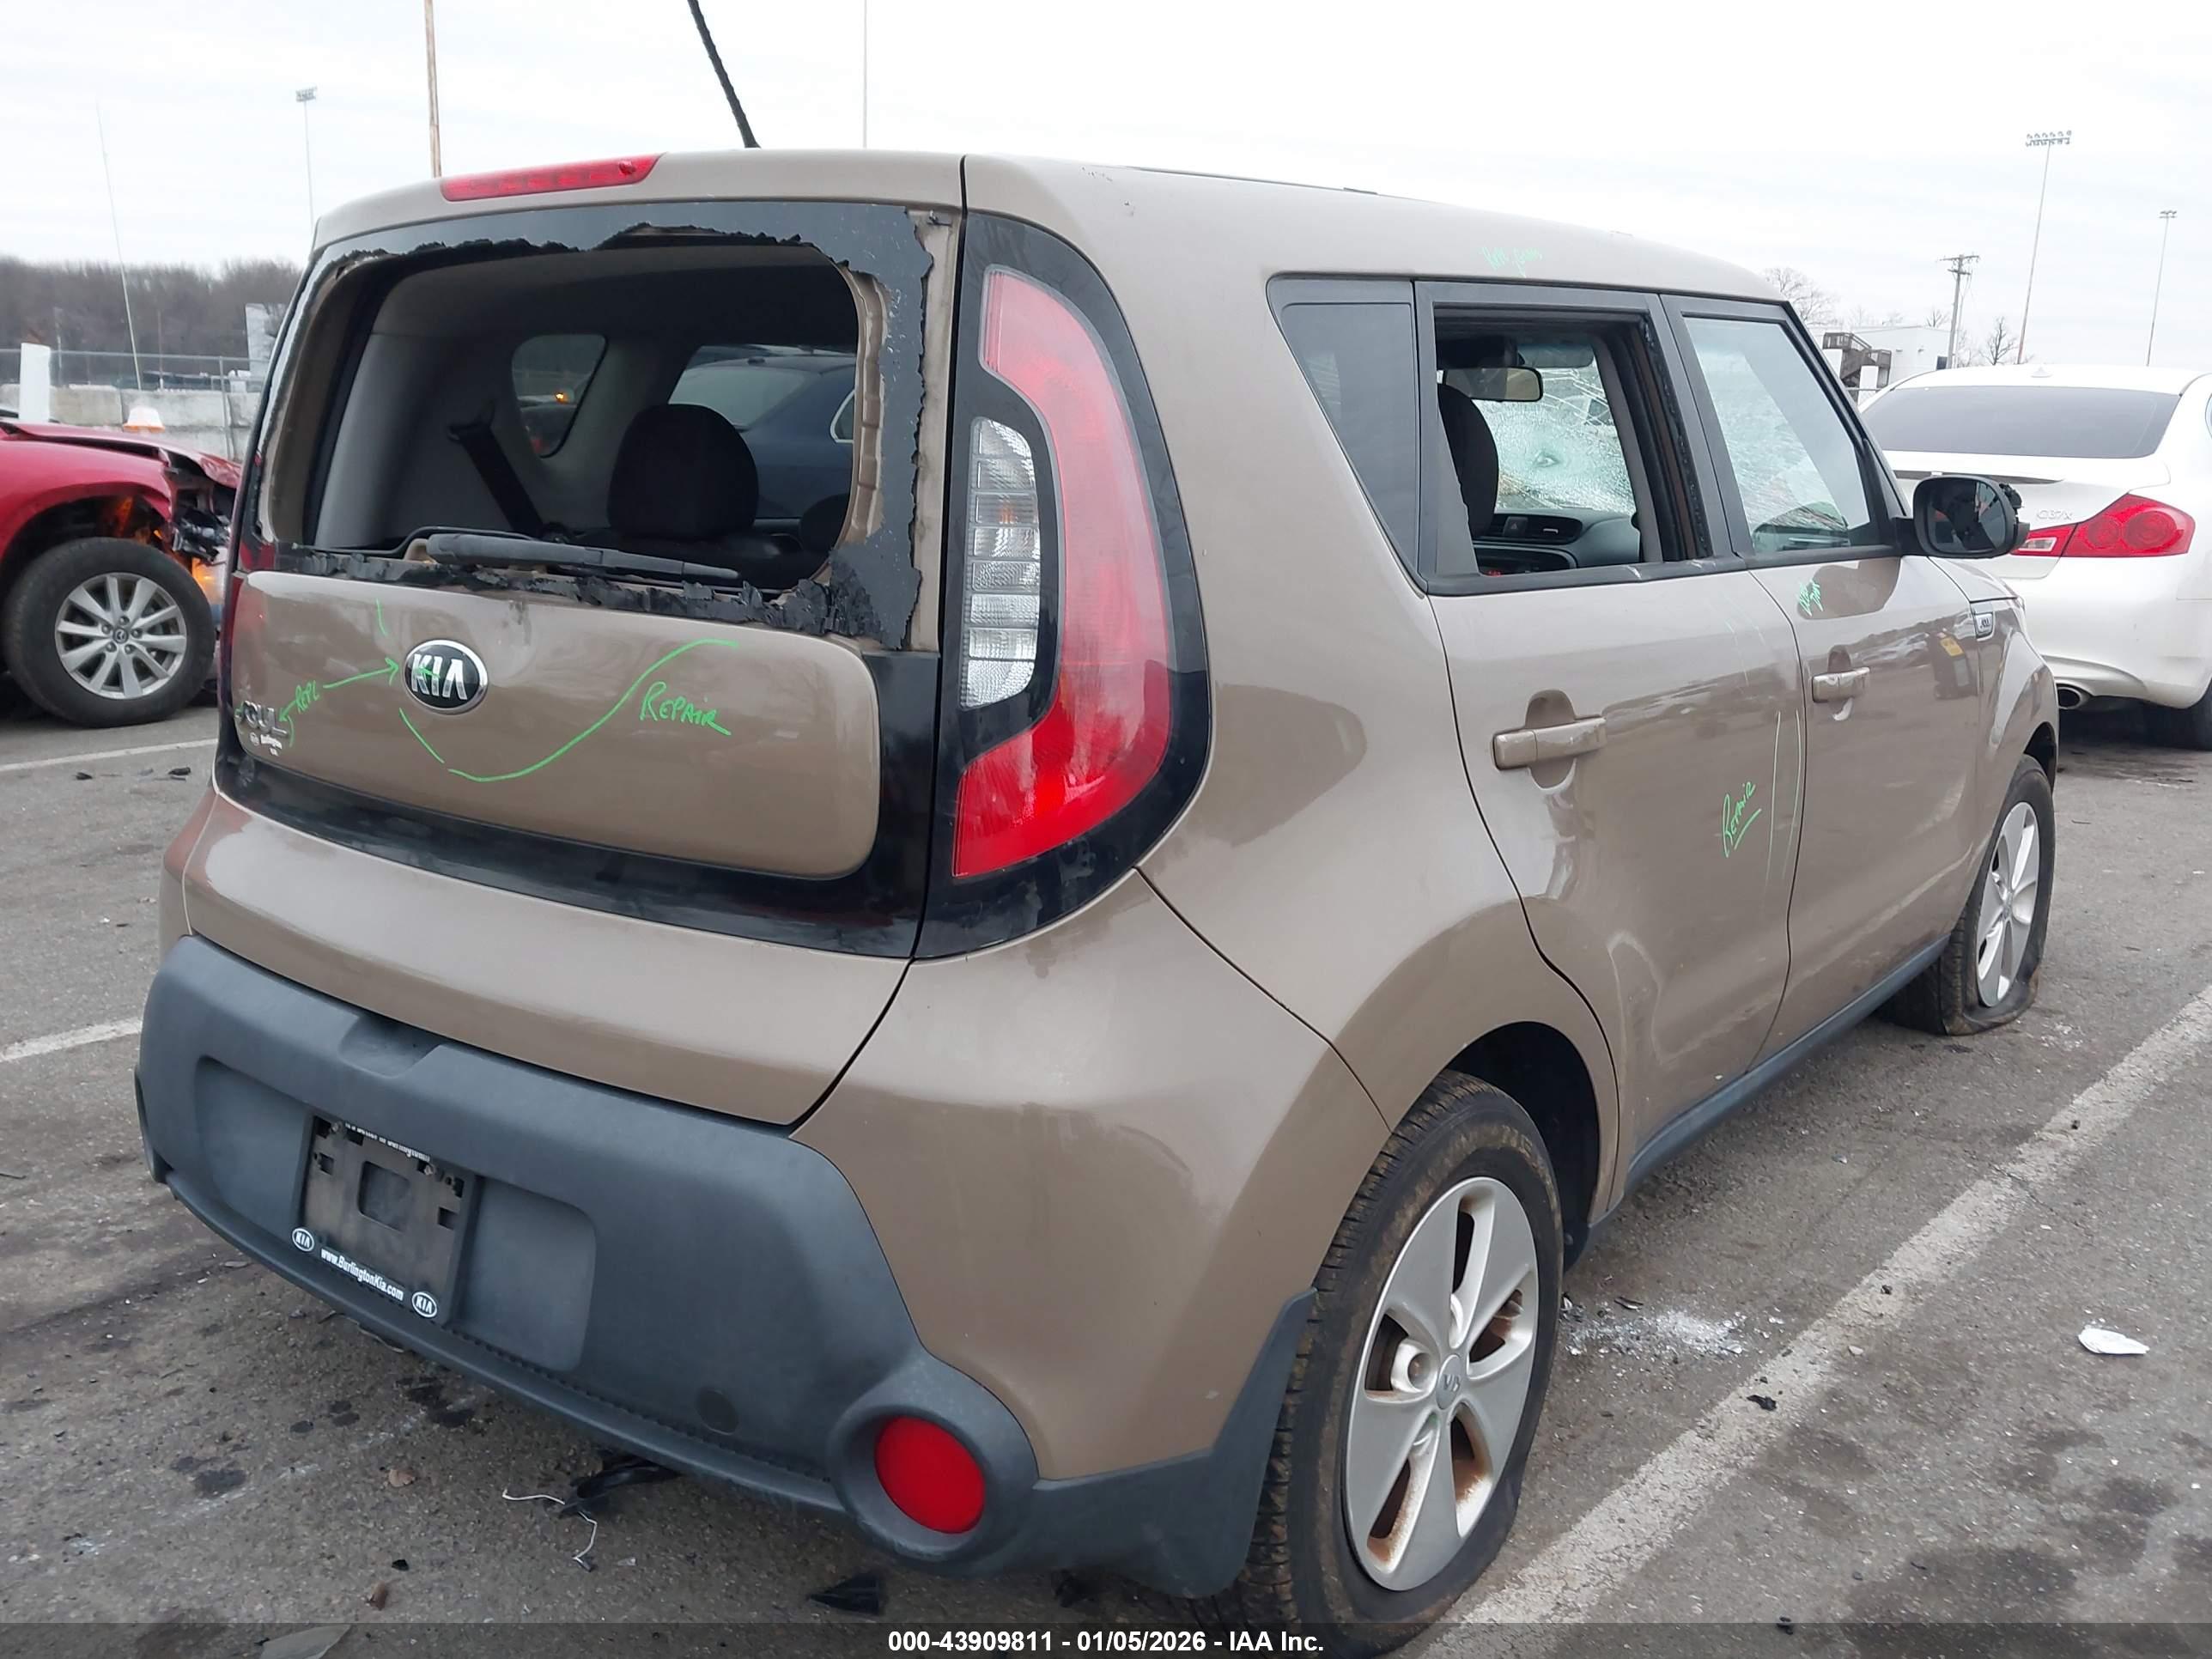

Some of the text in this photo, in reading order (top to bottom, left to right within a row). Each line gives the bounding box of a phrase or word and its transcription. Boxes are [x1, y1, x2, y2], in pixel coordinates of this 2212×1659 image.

[411, 653, 468, 700] KIA
[295, 1231, 311, 1249] KIA
[321, 1248, 404, 1301] www.BurlingtonKia.com
[415, 1297, 433, 1315] KIA
